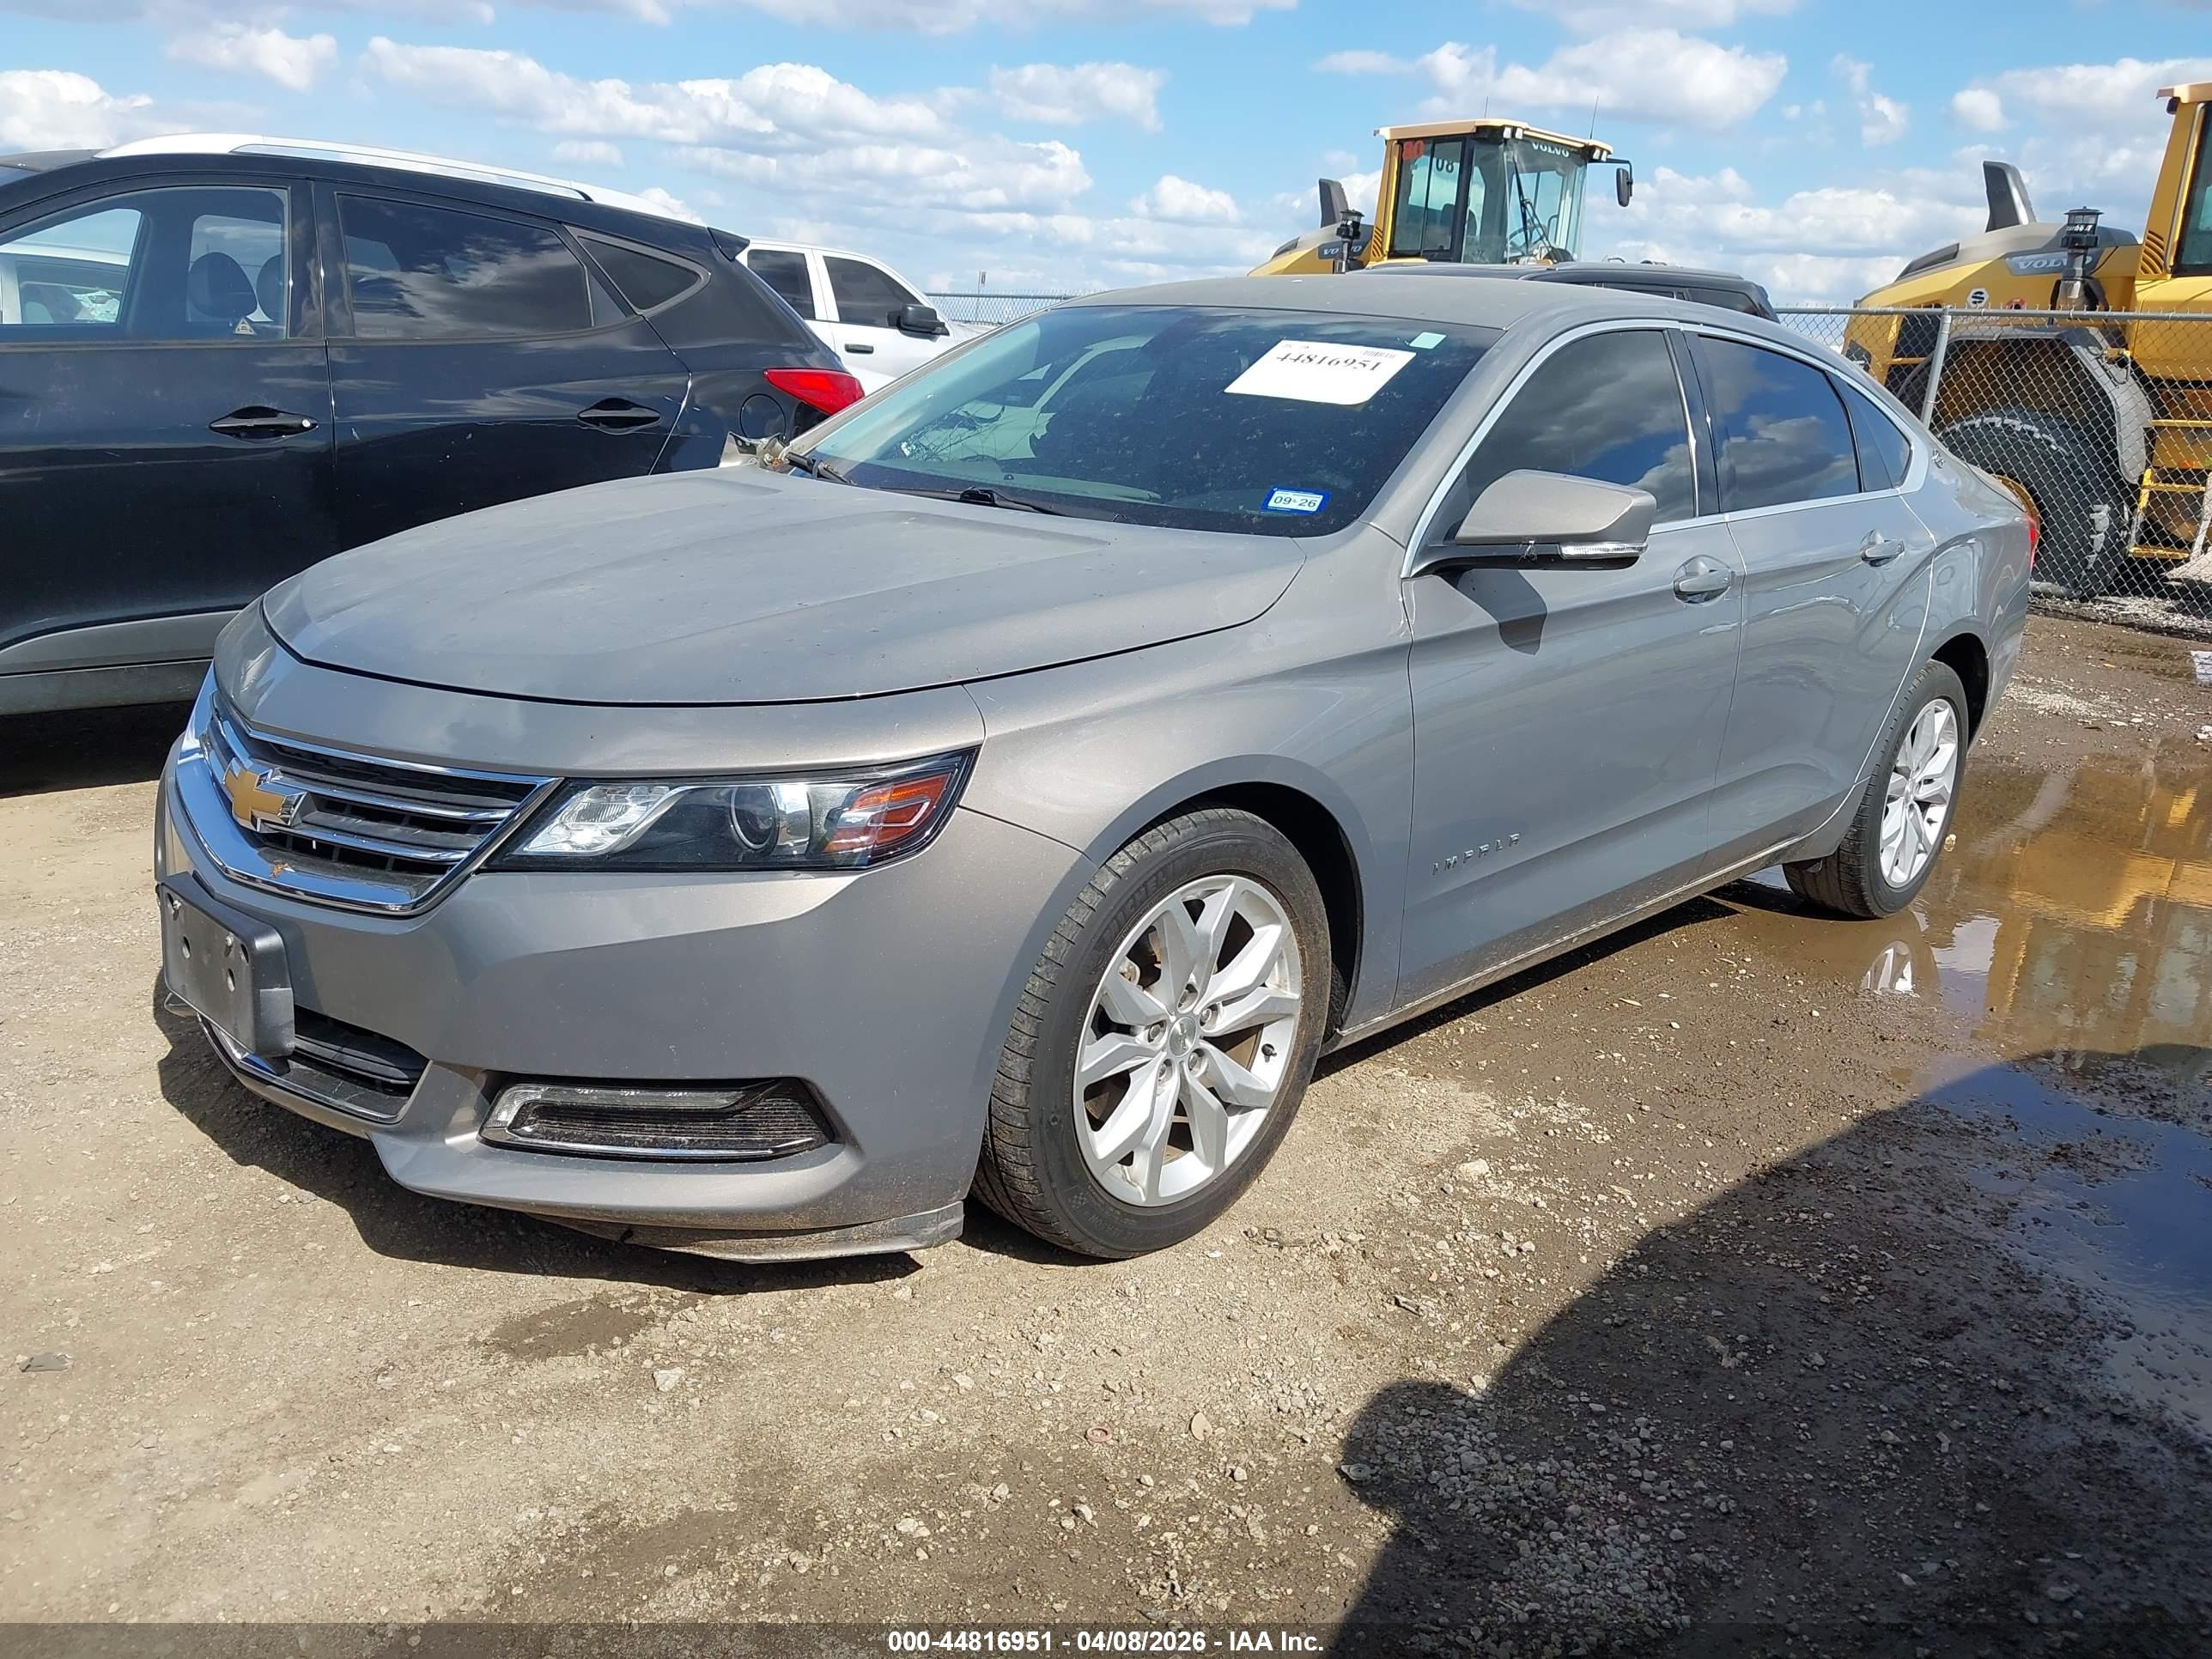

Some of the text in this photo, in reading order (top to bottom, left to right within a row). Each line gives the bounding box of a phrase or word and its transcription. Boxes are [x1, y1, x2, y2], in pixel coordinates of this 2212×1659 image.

[1532, 142, 1570, 157] VOLVO
[1277, 353, 1381, 371] 44816951
[1432, 833, 1520, 876] IMPALA
